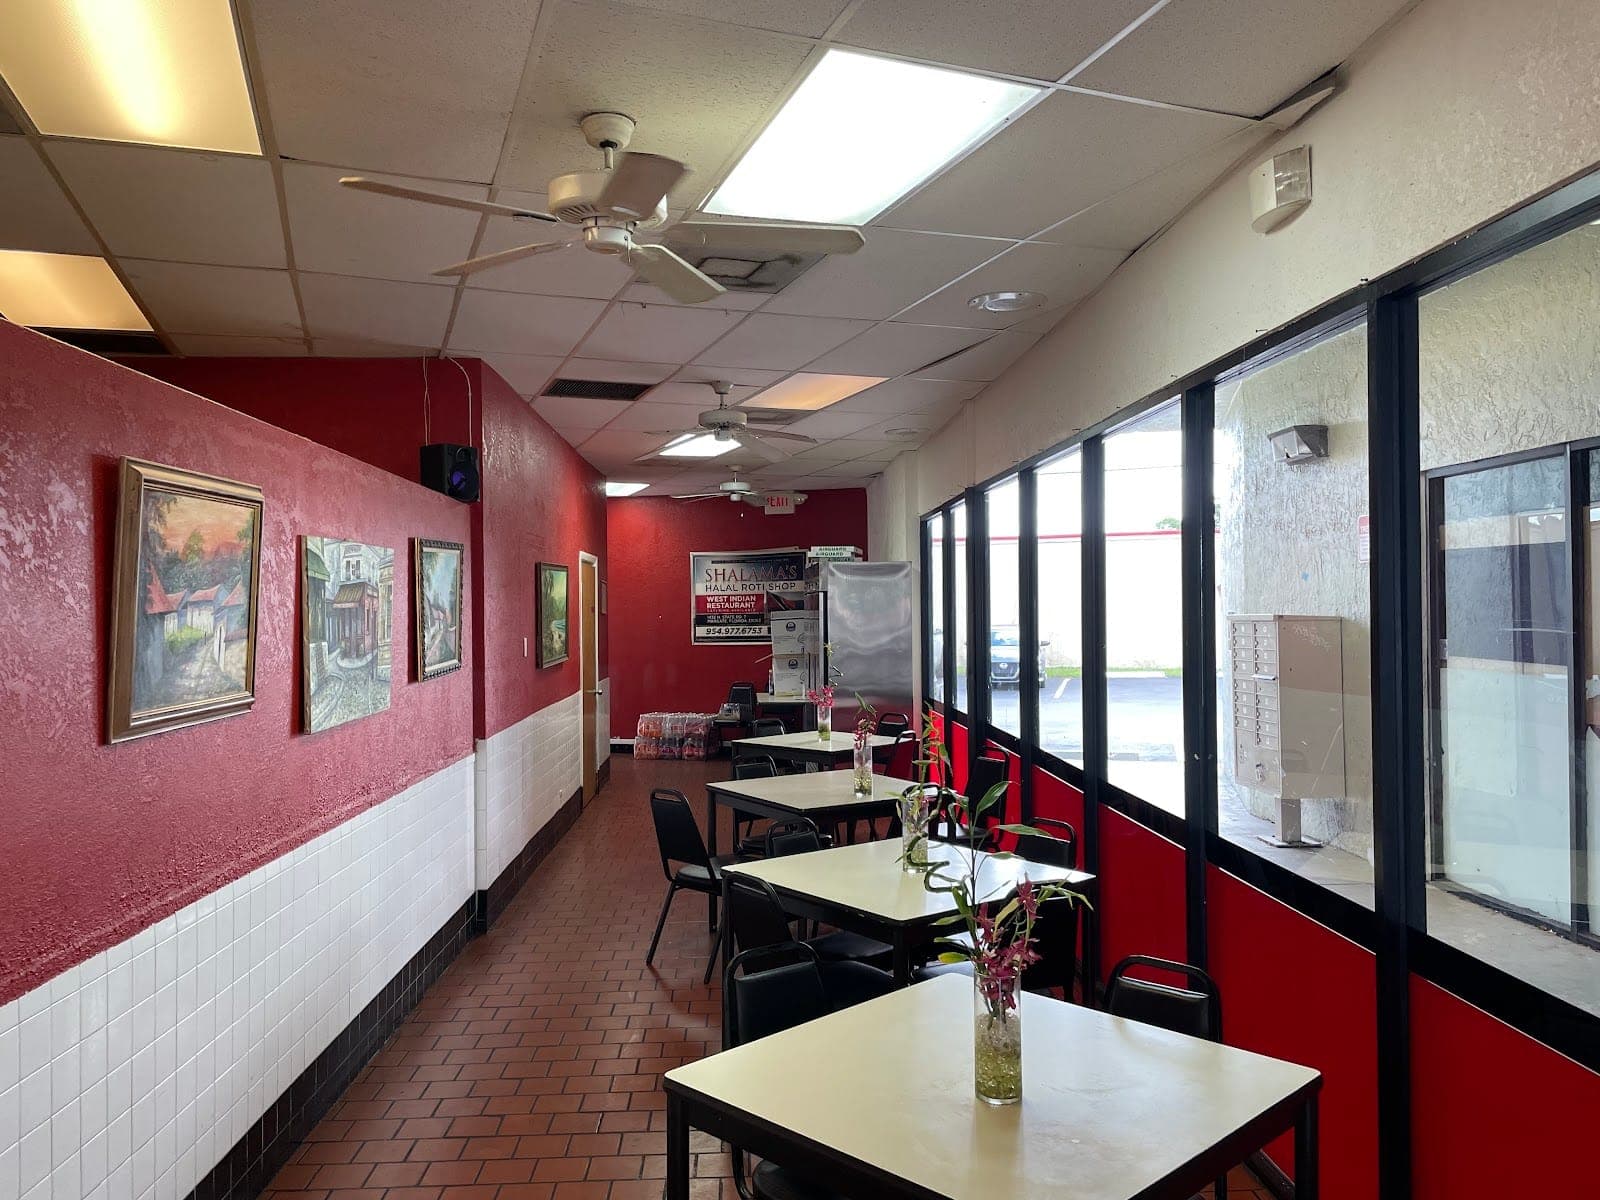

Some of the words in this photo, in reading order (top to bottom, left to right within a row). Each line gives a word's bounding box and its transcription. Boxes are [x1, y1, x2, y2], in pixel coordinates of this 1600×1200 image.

[770, 496, 788, 506] EXIT
[705, 565, 797, 583] SHALAMA'S
[705, 584, 738, 592] HALAL
[741, 583, 765, 591] ROTI
[768, 582, 796, 591] SHOP
